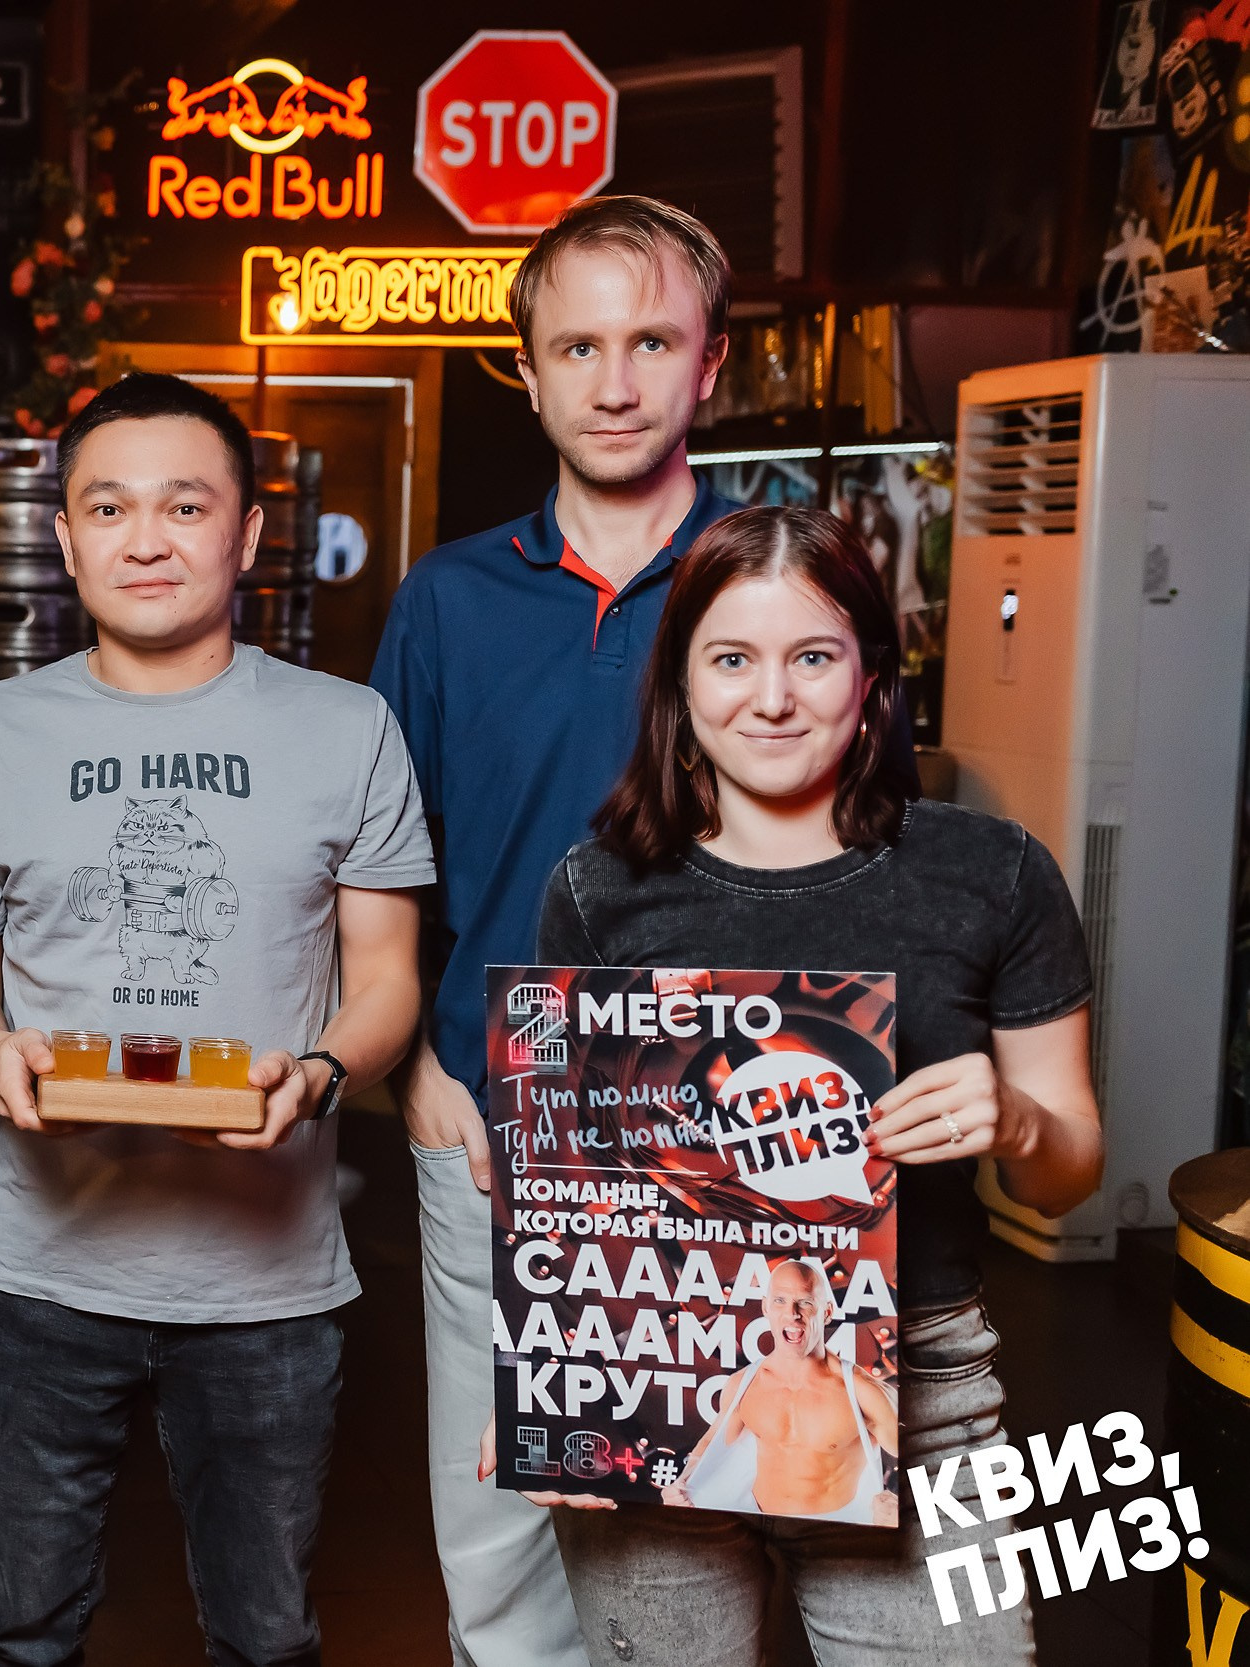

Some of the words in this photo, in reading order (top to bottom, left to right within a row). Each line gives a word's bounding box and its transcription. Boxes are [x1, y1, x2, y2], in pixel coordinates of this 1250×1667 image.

[440, 100, 600, 168] STOP
[147, 152, 262, 219] Red
[272, 152, 384, 220] Bull
[267, 246, 522, 334] Jägerm
[69, 756, 122, 802] GO
[141, 752, 252, 799] HARD
[112, 986, 131, 1004] OR
[137, 987, 155, 1005] GO
[160, 988, 200, 1008] HOME
[507, 983, 568, 1073] 2
[578, 991, 783, 1040] МЕСТО
[501, 1070, 579, 1137] Тут
[493, 1118, 557, 1175] Тут
[567, 1126, 614, 1155] не
[513, 1177, 669, 1211] КОМАНДЕ,
[513, 1209, 651, 1239] КОТОРАЯ
[657, 1217, 747, 1244] БЫЛА
[751, 1222, 860, 1251] ПОЧТИ
[515, 1425, 645, 1480] 18+
